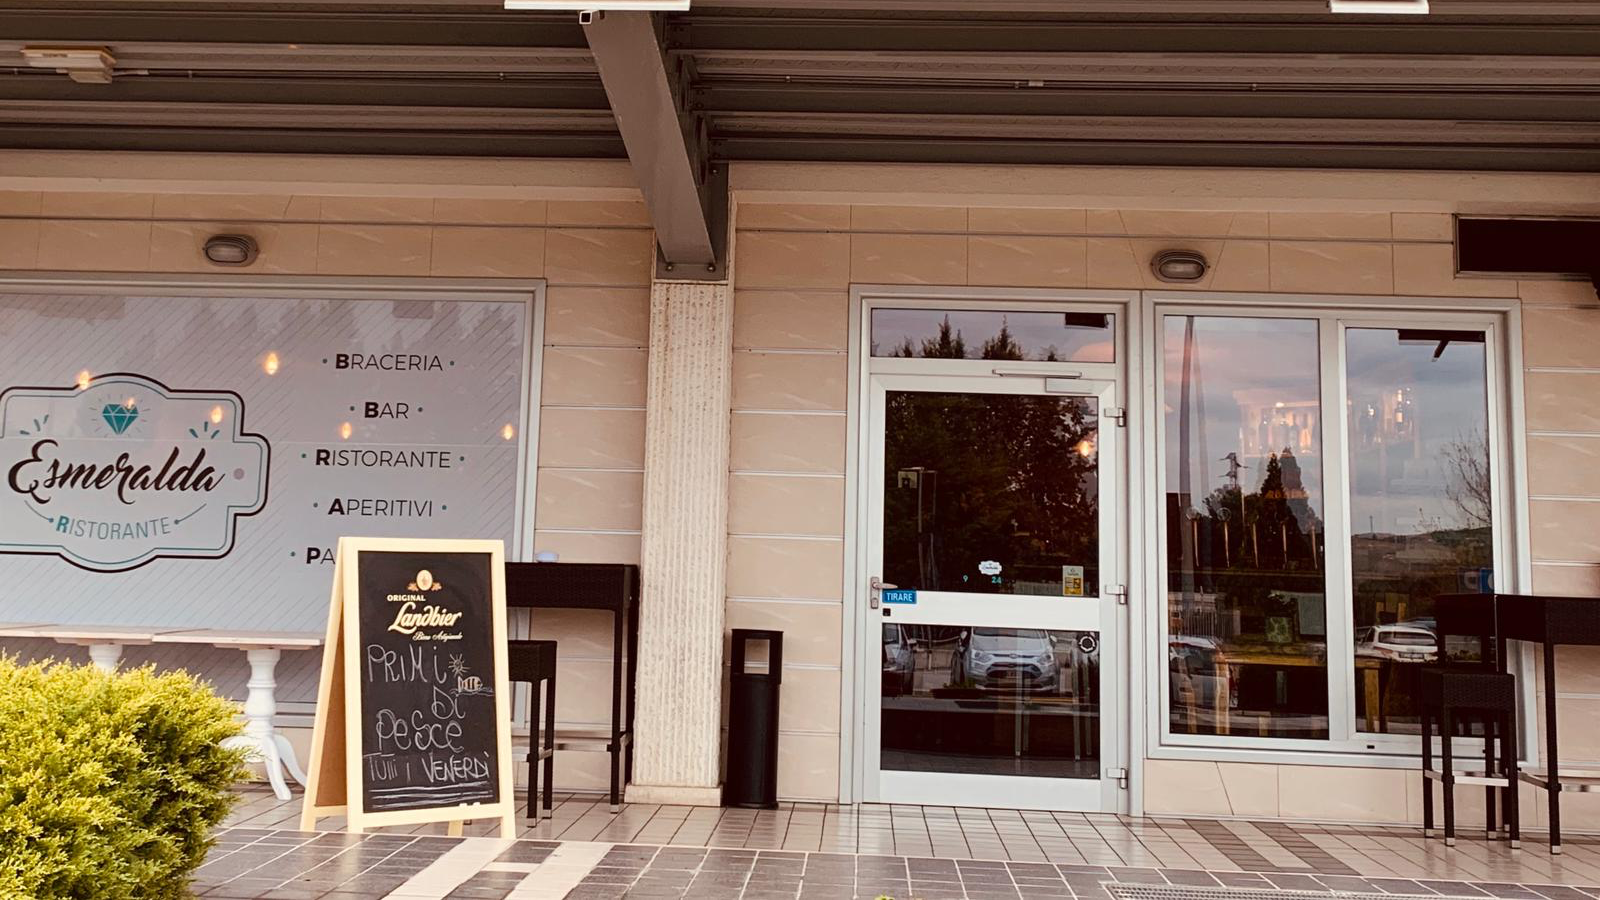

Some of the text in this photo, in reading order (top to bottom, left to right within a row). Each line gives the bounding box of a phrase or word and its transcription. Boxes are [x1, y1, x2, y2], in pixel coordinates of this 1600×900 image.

[335, 353, 443, 371] BRACERIA
[364, 401, 409, 419] BAR
[315, 449, 451, 468] RISTORANTE
[8, 439, 226, 505] Esmeralda
[328, 498, 433, 517] APERITIVI
[56, 515, 171, 540] RISTORANTE
[306, 546, 336, 565] PA
[386, 594, 426, 602] ORIGINAL
[886, 592, 913, 602] TIRARE
[387, 601, 462, 635] Landbier
